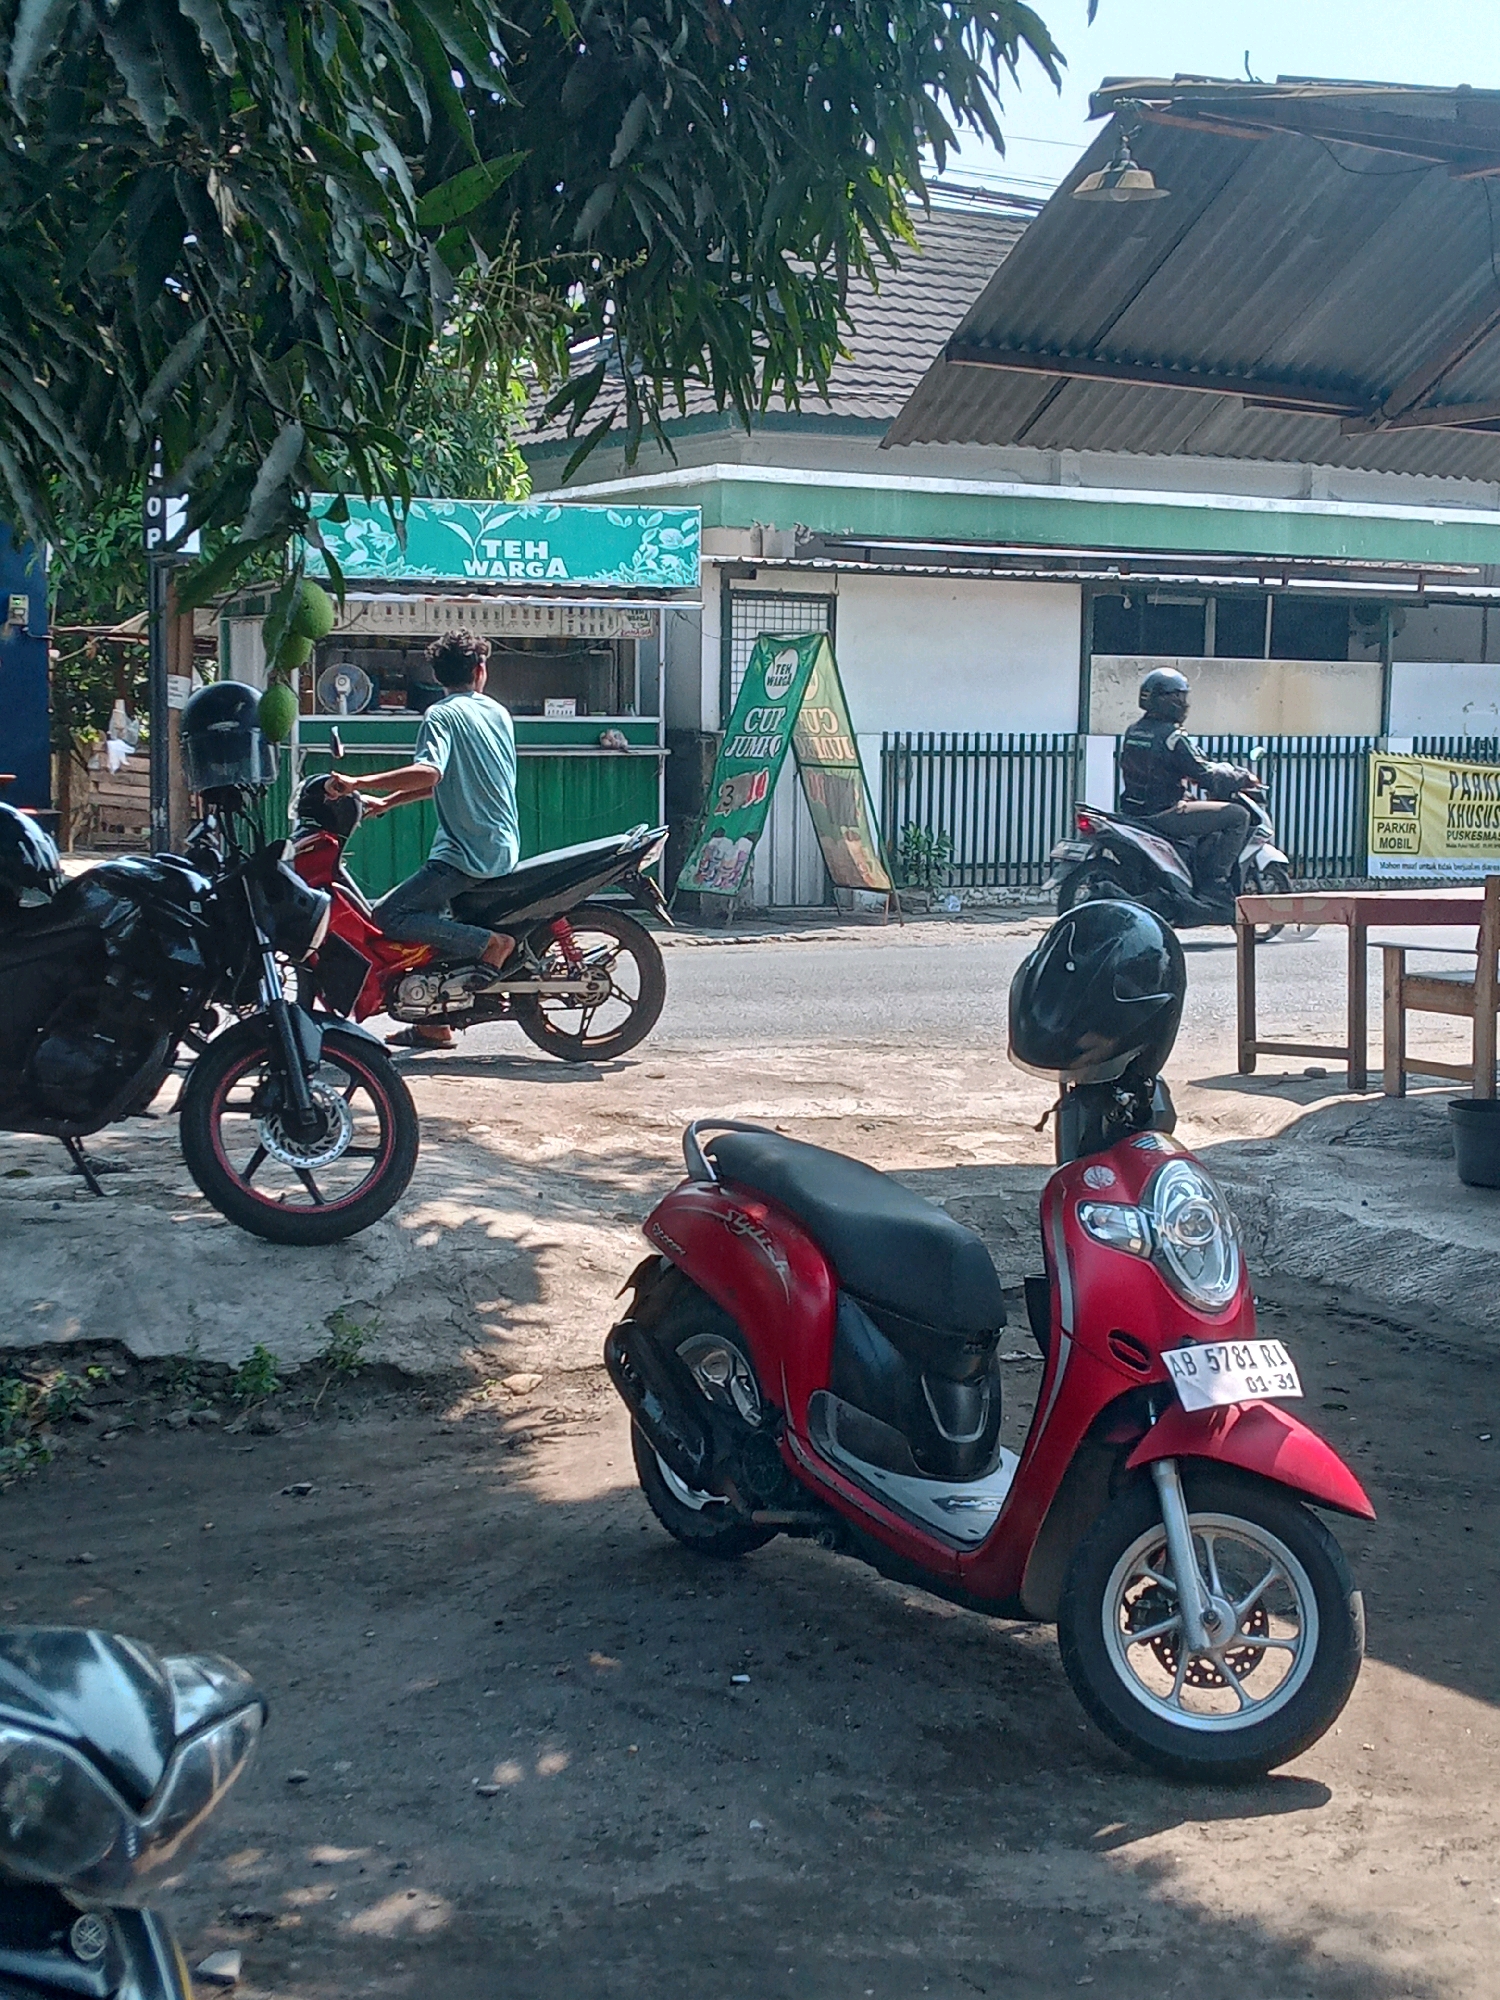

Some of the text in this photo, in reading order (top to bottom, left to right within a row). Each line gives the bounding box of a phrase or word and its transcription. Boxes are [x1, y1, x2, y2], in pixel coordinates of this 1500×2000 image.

[481, 539, 549, 560] TEH
[463, 557, 569, 578] WARGA
[775, 663, 792, 675] TEH
[1377, 765, 1396, 797] P
[1377, 822, 1417, 834] PARKIR
[1379, 836, 1412, 850] MOBIL
[1169, 1344, 1288, 1378] AB 5781 RI
